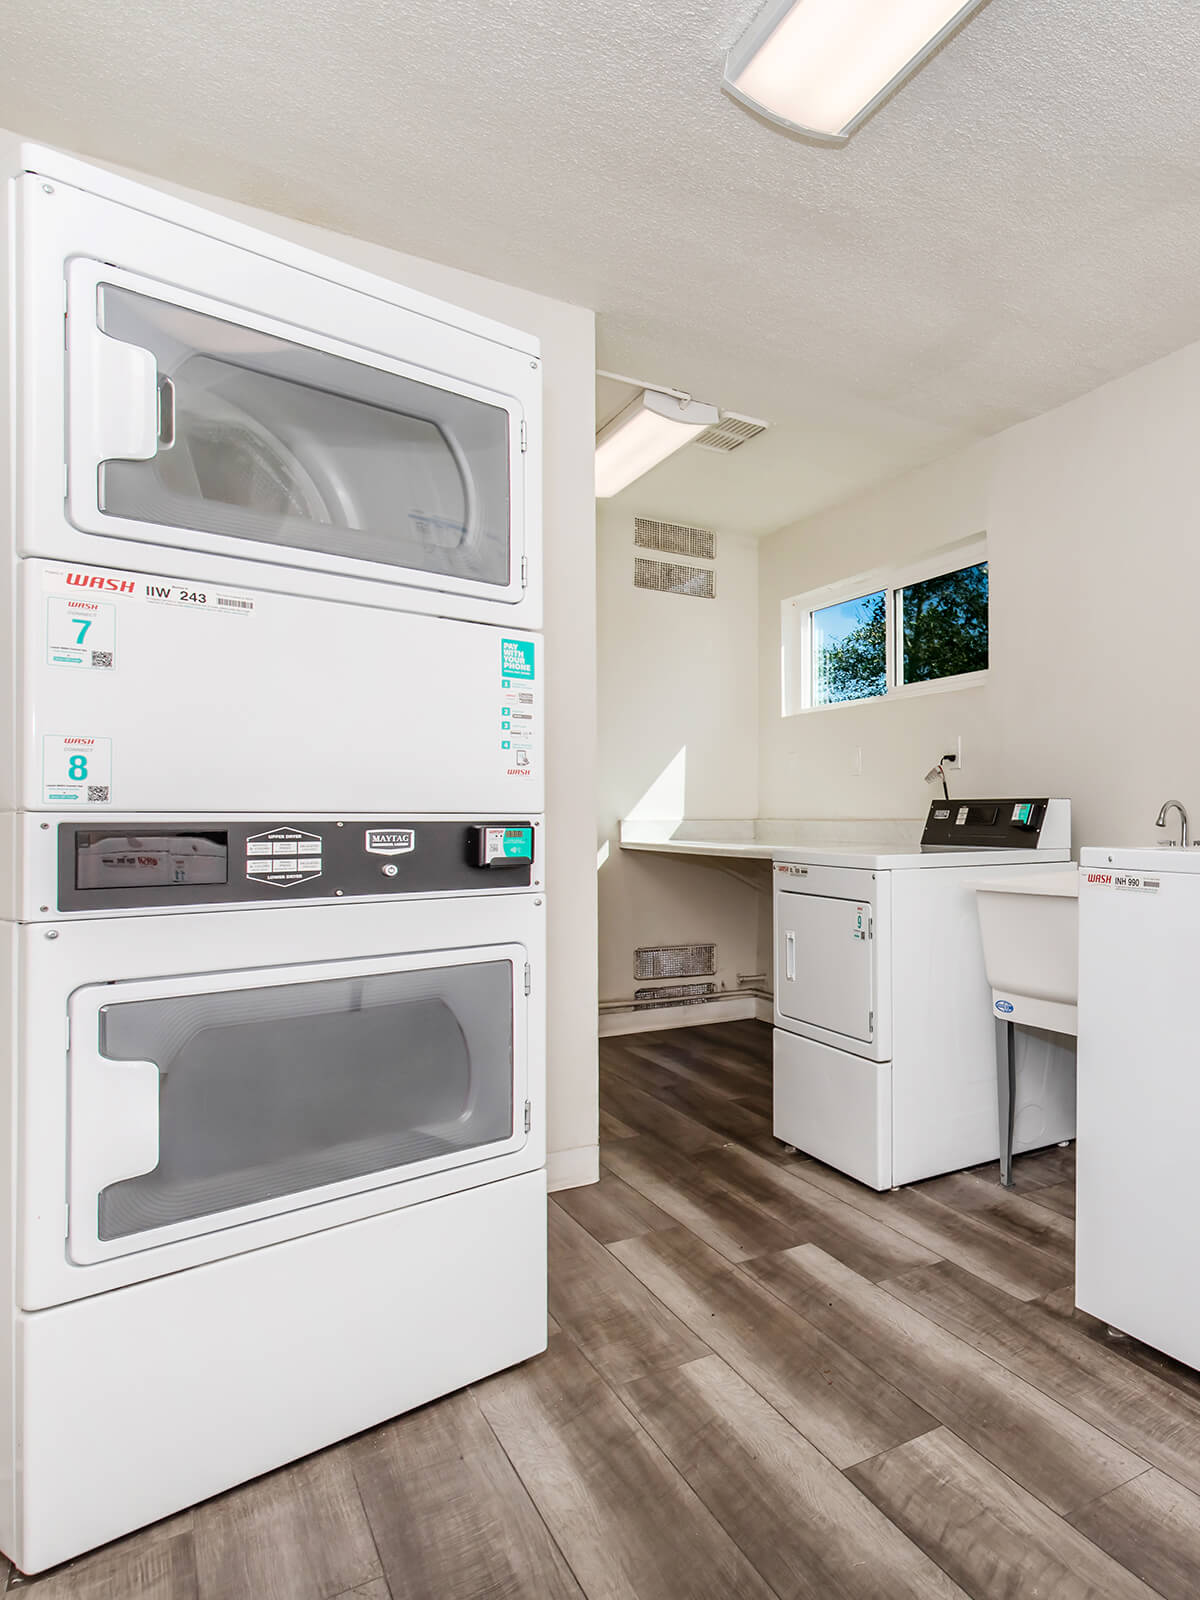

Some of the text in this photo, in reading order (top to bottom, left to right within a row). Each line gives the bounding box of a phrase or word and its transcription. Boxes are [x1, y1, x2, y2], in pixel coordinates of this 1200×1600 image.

[66, 573, 135, 592] WASH
[146, 586, 170, 598] IIW
[180, 591, 207, 603] 243
[68, 601, 98, 609] WASH
[72, 619, 91, 644] 7
[504, 650, 524, 658] WITH
[504, 656, 525, 664] YOUR
[504, 663, 530, 671] PHONE
[68, 755, 88, 781] 8
[1088, 873, 1111, 884] WASH
[1115, 877, 1126, 885] INH
